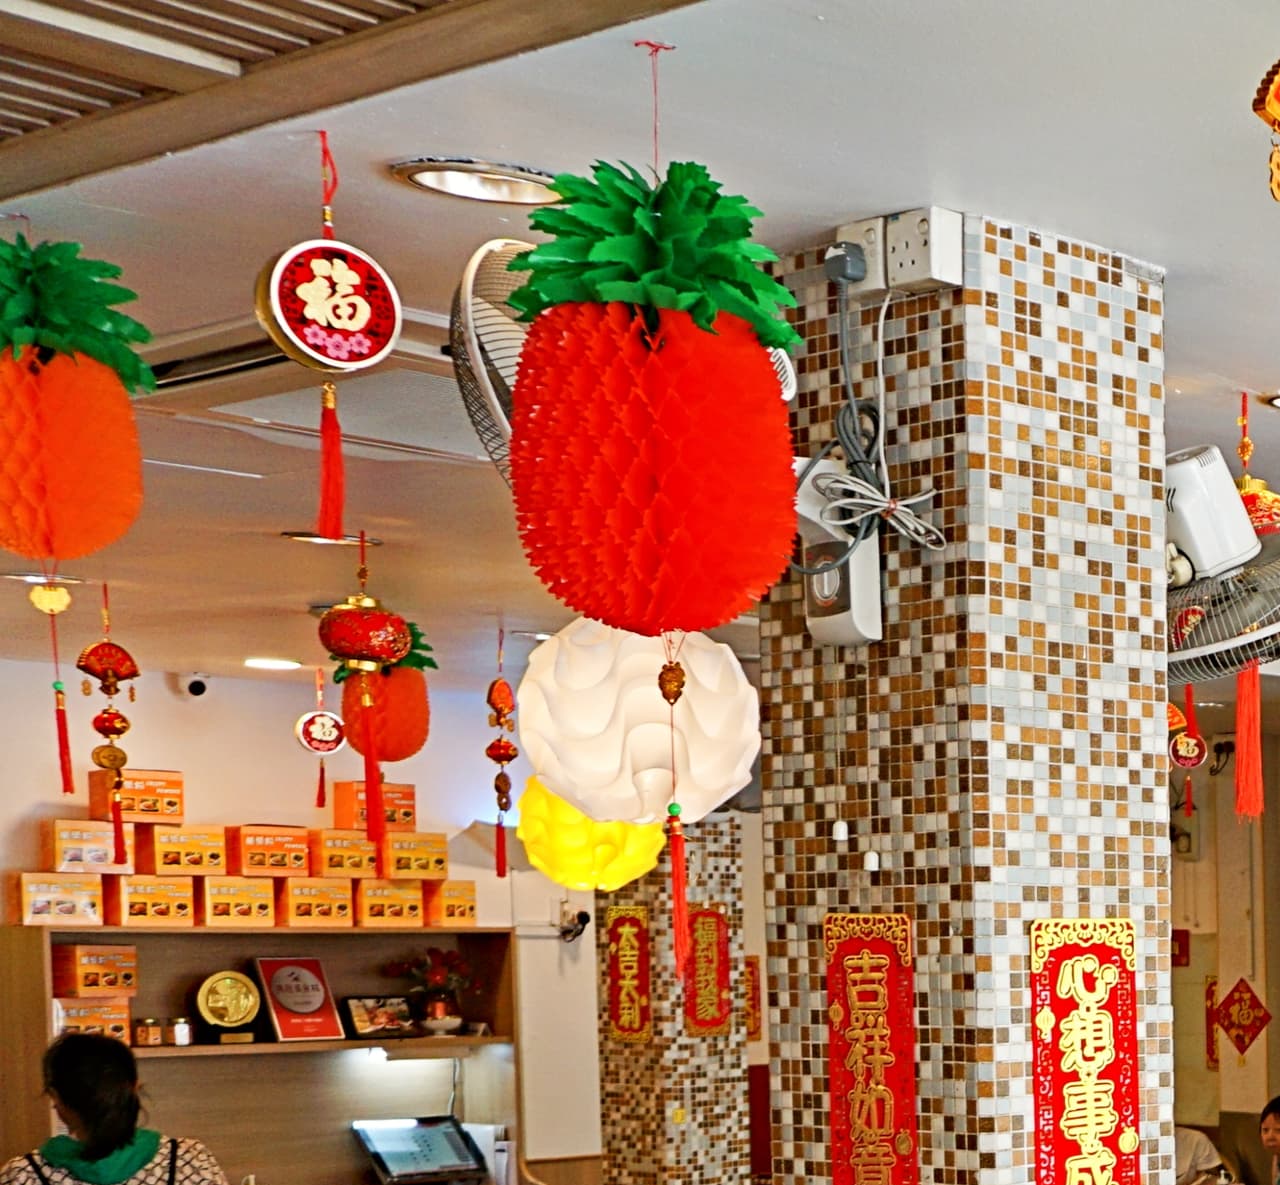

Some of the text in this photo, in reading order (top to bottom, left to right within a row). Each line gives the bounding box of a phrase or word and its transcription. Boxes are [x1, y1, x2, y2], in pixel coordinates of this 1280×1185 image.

[296, 258, 371, 332] 福
[618, 923, 640, 1029] 大吉大利
